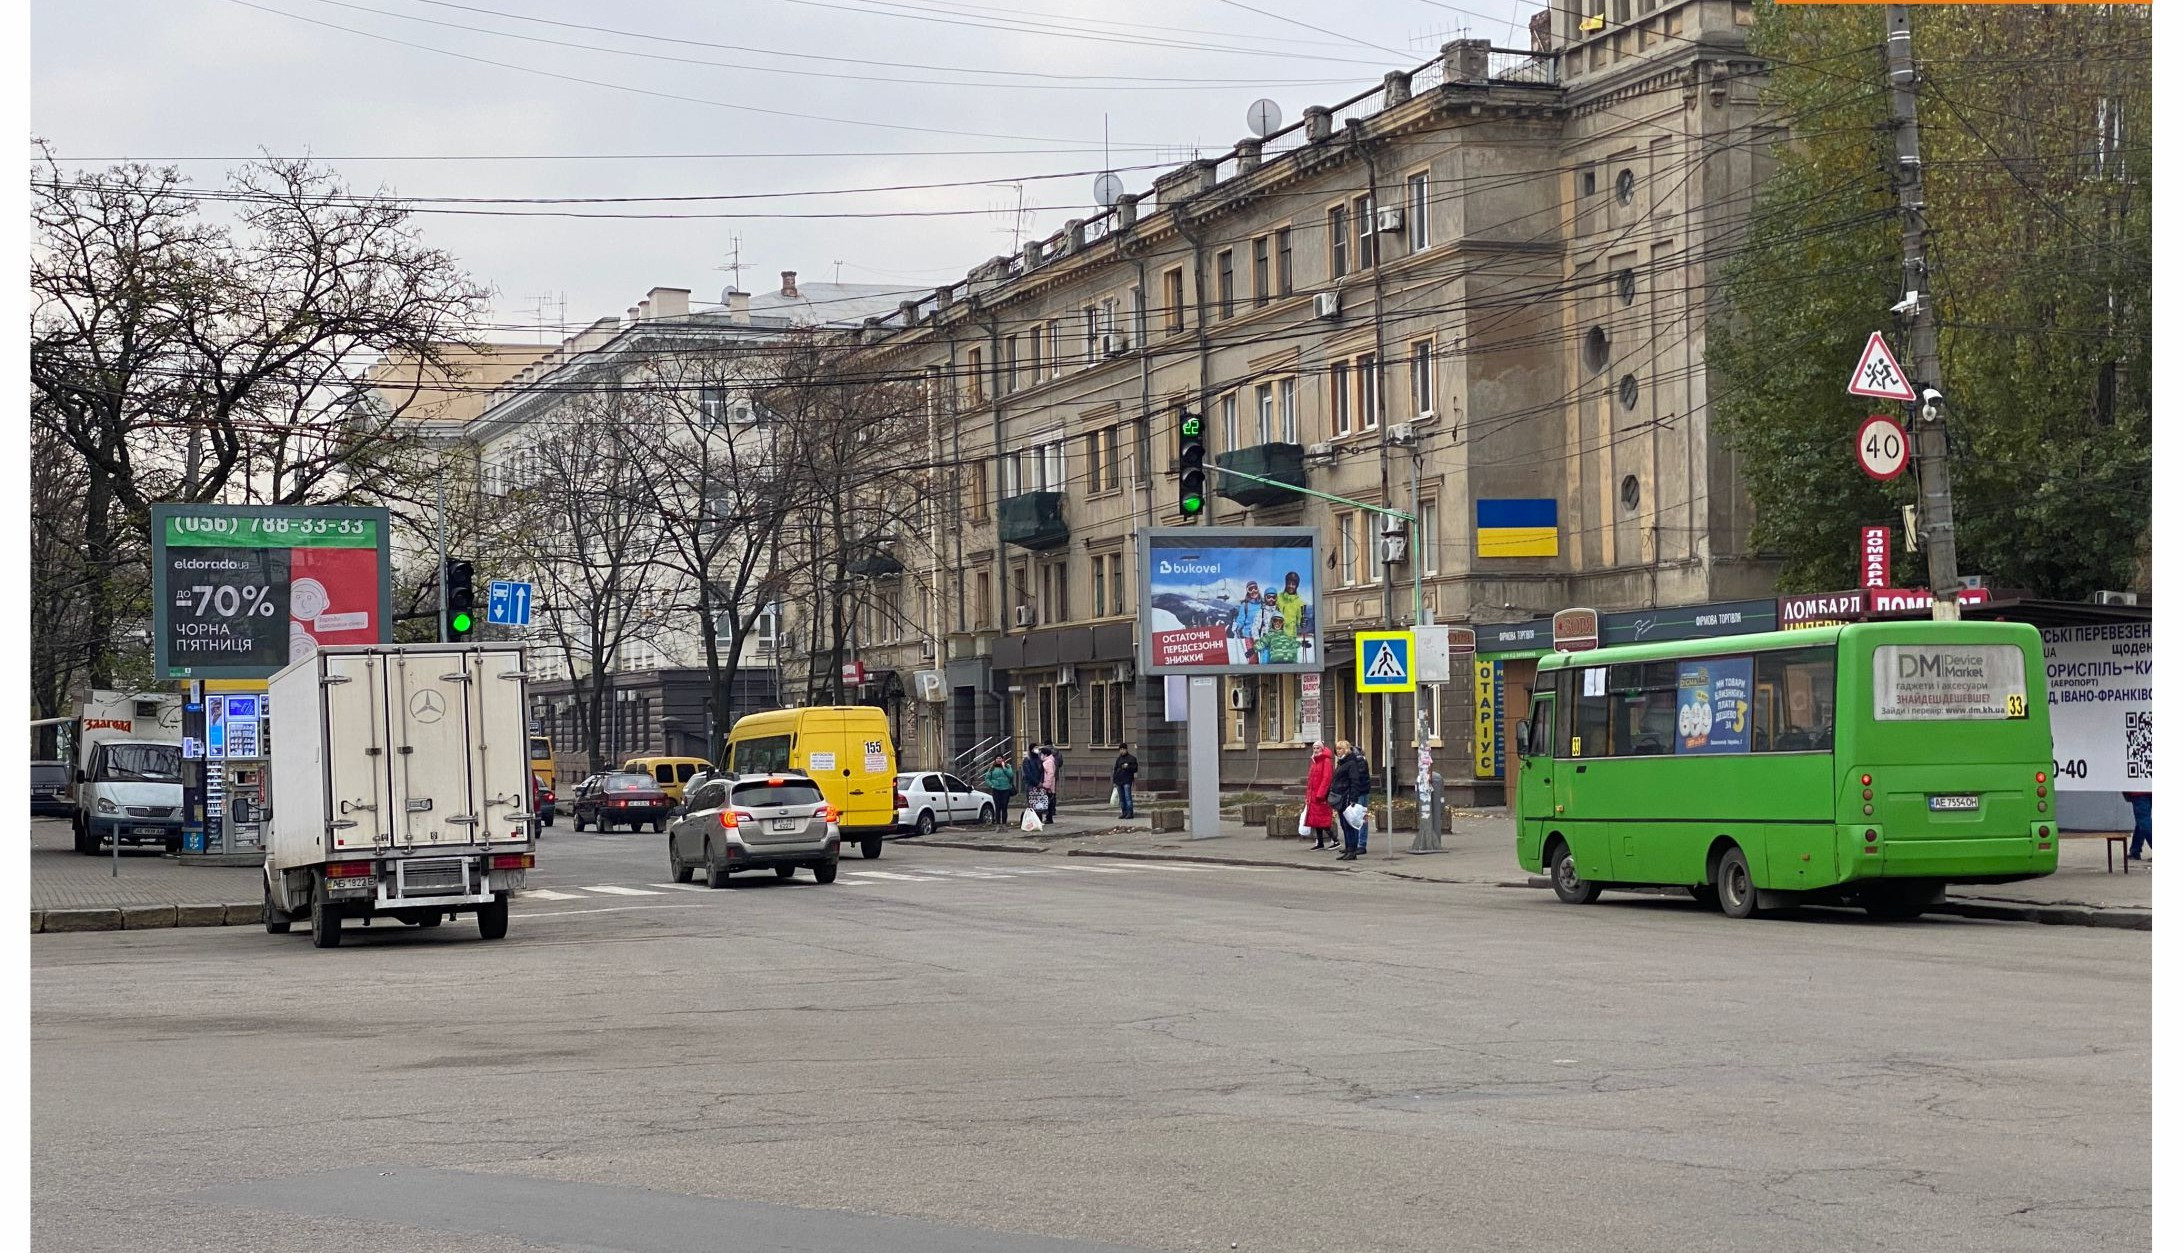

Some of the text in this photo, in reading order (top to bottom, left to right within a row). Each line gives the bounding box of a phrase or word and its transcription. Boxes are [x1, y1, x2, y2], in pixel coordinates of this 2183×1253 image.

[1183, 419, 1199, 434] 22
[1866, 434, 1899, 458] 40
[175, 517, 364, 534] (056) 788-33-33
[1867, 529, 1884, 586] ЛОМБАРД
[1174, 563, 1220, 573] bukovel
[176, 590, 190, 598] до
[176, 585, 274, 616] -70%
[176, 624, 230, 635] ЧОРНА
[1162, 630, 1210, 643] ОСТАТОЧНІ
[1163, 640, 1223, 654] ПЕРЕДСЕЗОННІ
[1165, 652, 1204, 665] ЗНИЖКИ!
[1945, 655, 1983, 665] Device
[1945, 666, 1983, 677] Market
[1897, 683, 1934, 692] гаджети
[1942, 682, 1988, 692] аксесуари
[2051, 678, 2098, 688] (АЕРОПОРТ)
[1897, 693, 1990, 705] ЗНАЙДЕШ ДЕШЕВШЕ?
[2009, 696, 2023, 714] 33
[1480, 660, 1491, 768] ОТАРІУС
[1882, 706, 1905, 715] Зайди
[1945, 705, 2005, 714] www.dm.kh.ua
[865, 741, 882, 753] 155
